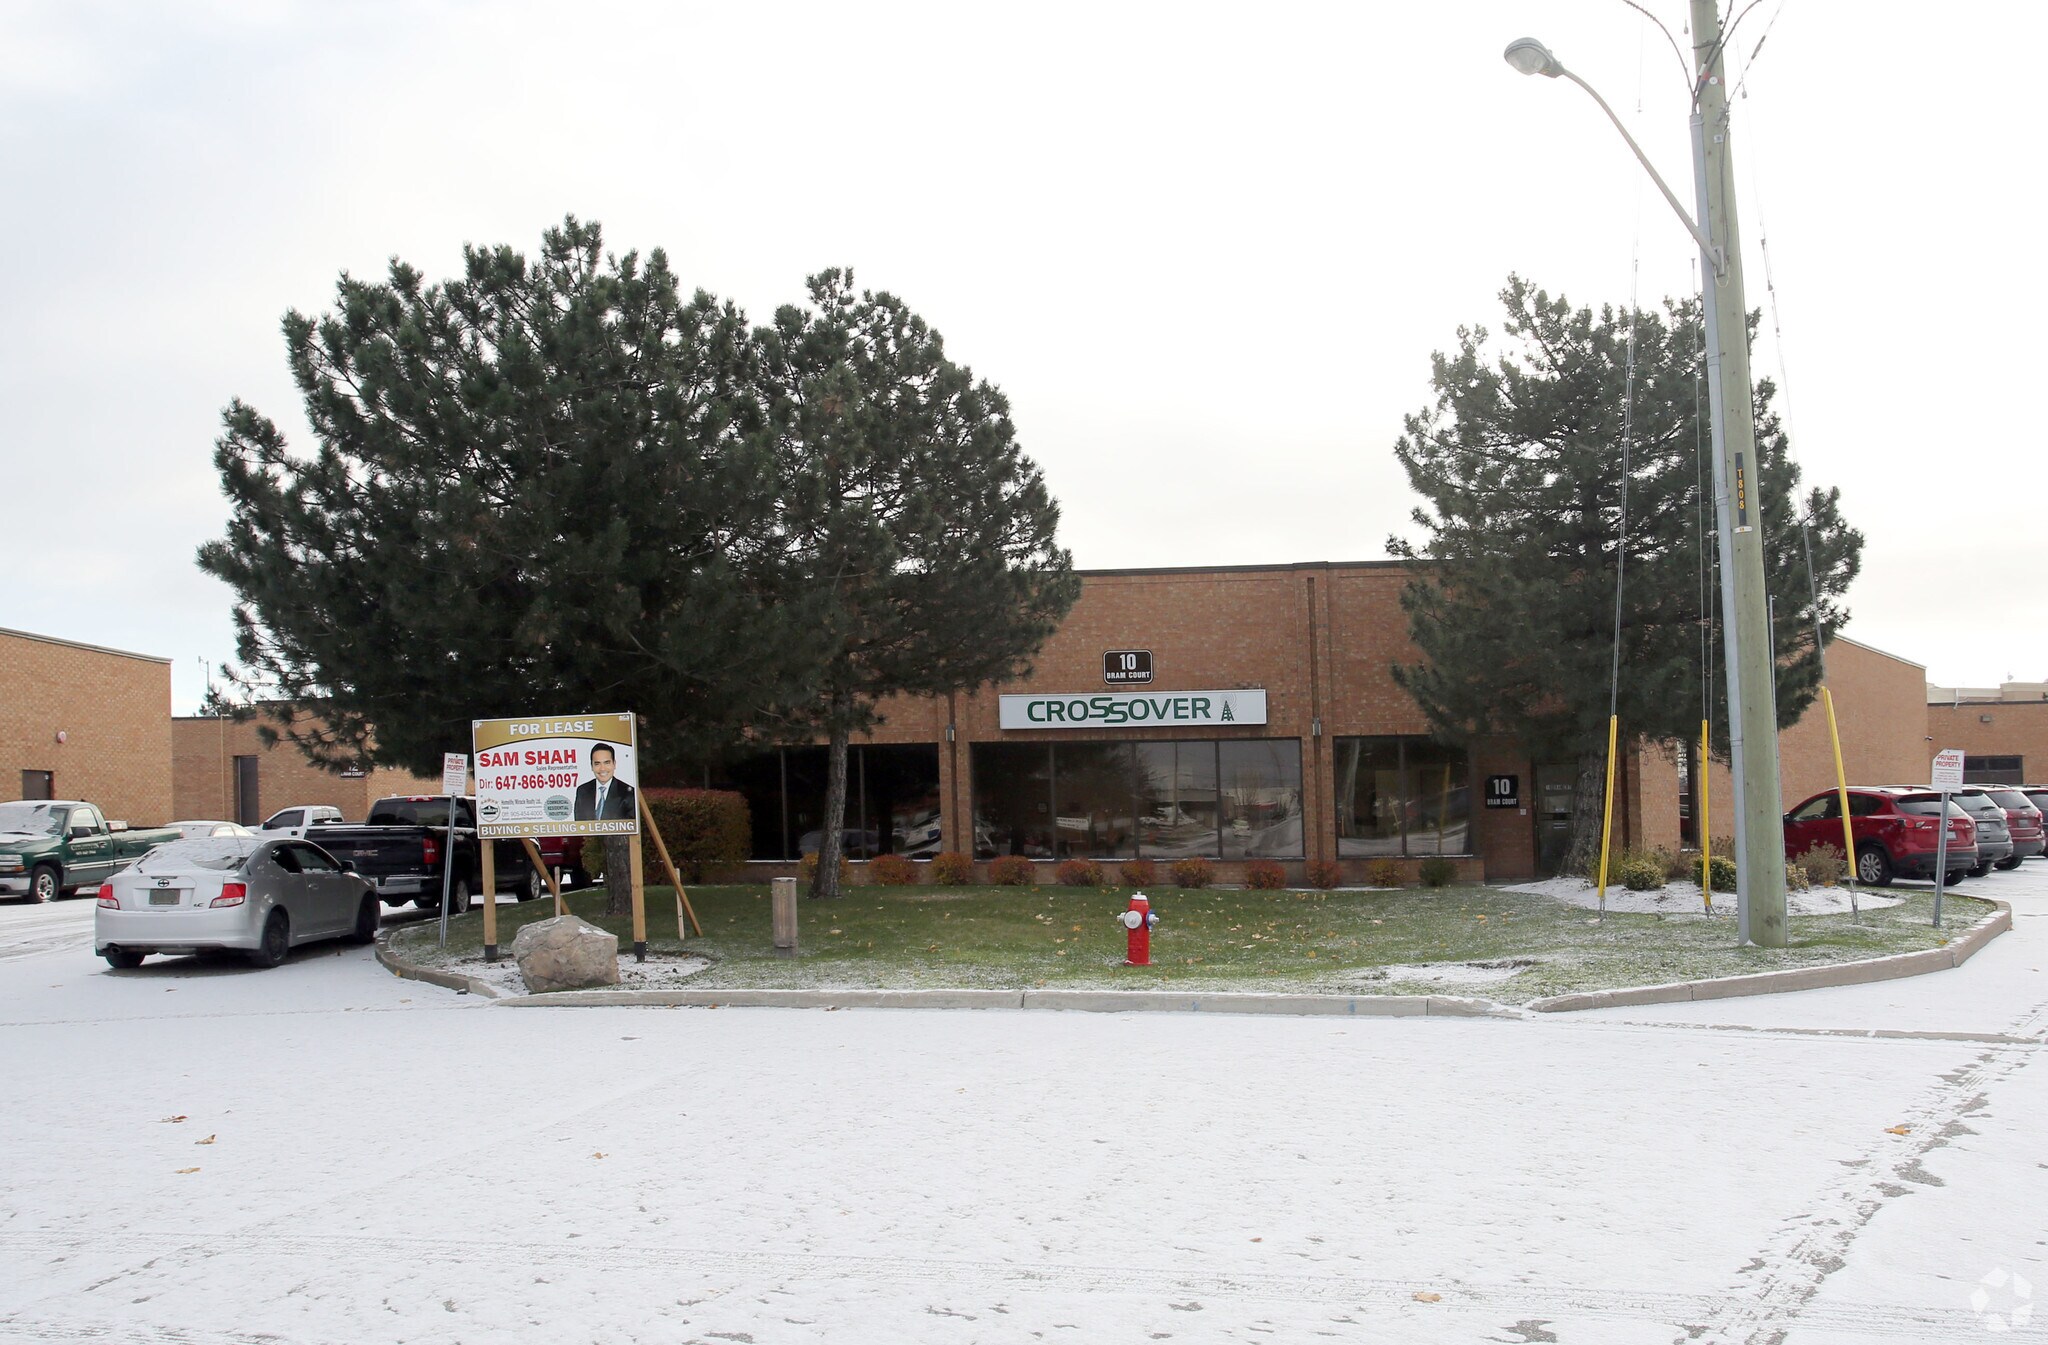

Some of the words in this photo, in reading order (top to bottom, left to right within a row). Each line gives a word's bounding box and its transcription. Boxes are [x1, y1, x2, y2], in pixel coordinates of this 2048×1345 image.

[1119, 653, 1137, 670] 10
[1106, 671, 1126, 679] BRAM
[1128, 671, 1150, 679] COURT
[1027, 696, 1211, 723] CROSSOVER
[509, 723, 540, 735] FOR
[545, 720, 594, 734] LEASE
[479, 751, 519, 767] SAM
[524, 749, 577, 765] SHAH
[1935, 760, 1961, 768] PROPERTY
[479, 778, 493, 789] Dir:
[495, 773, 579, 790] 647-866-9097
[1493, 778, 1511, 795] 10
[481, 825, 521, 835] BUYING
[532, 823, 577, 834] SELLING
[588, 821, 635, 832] LEASING
[353, 849, 379, 857] GMC
